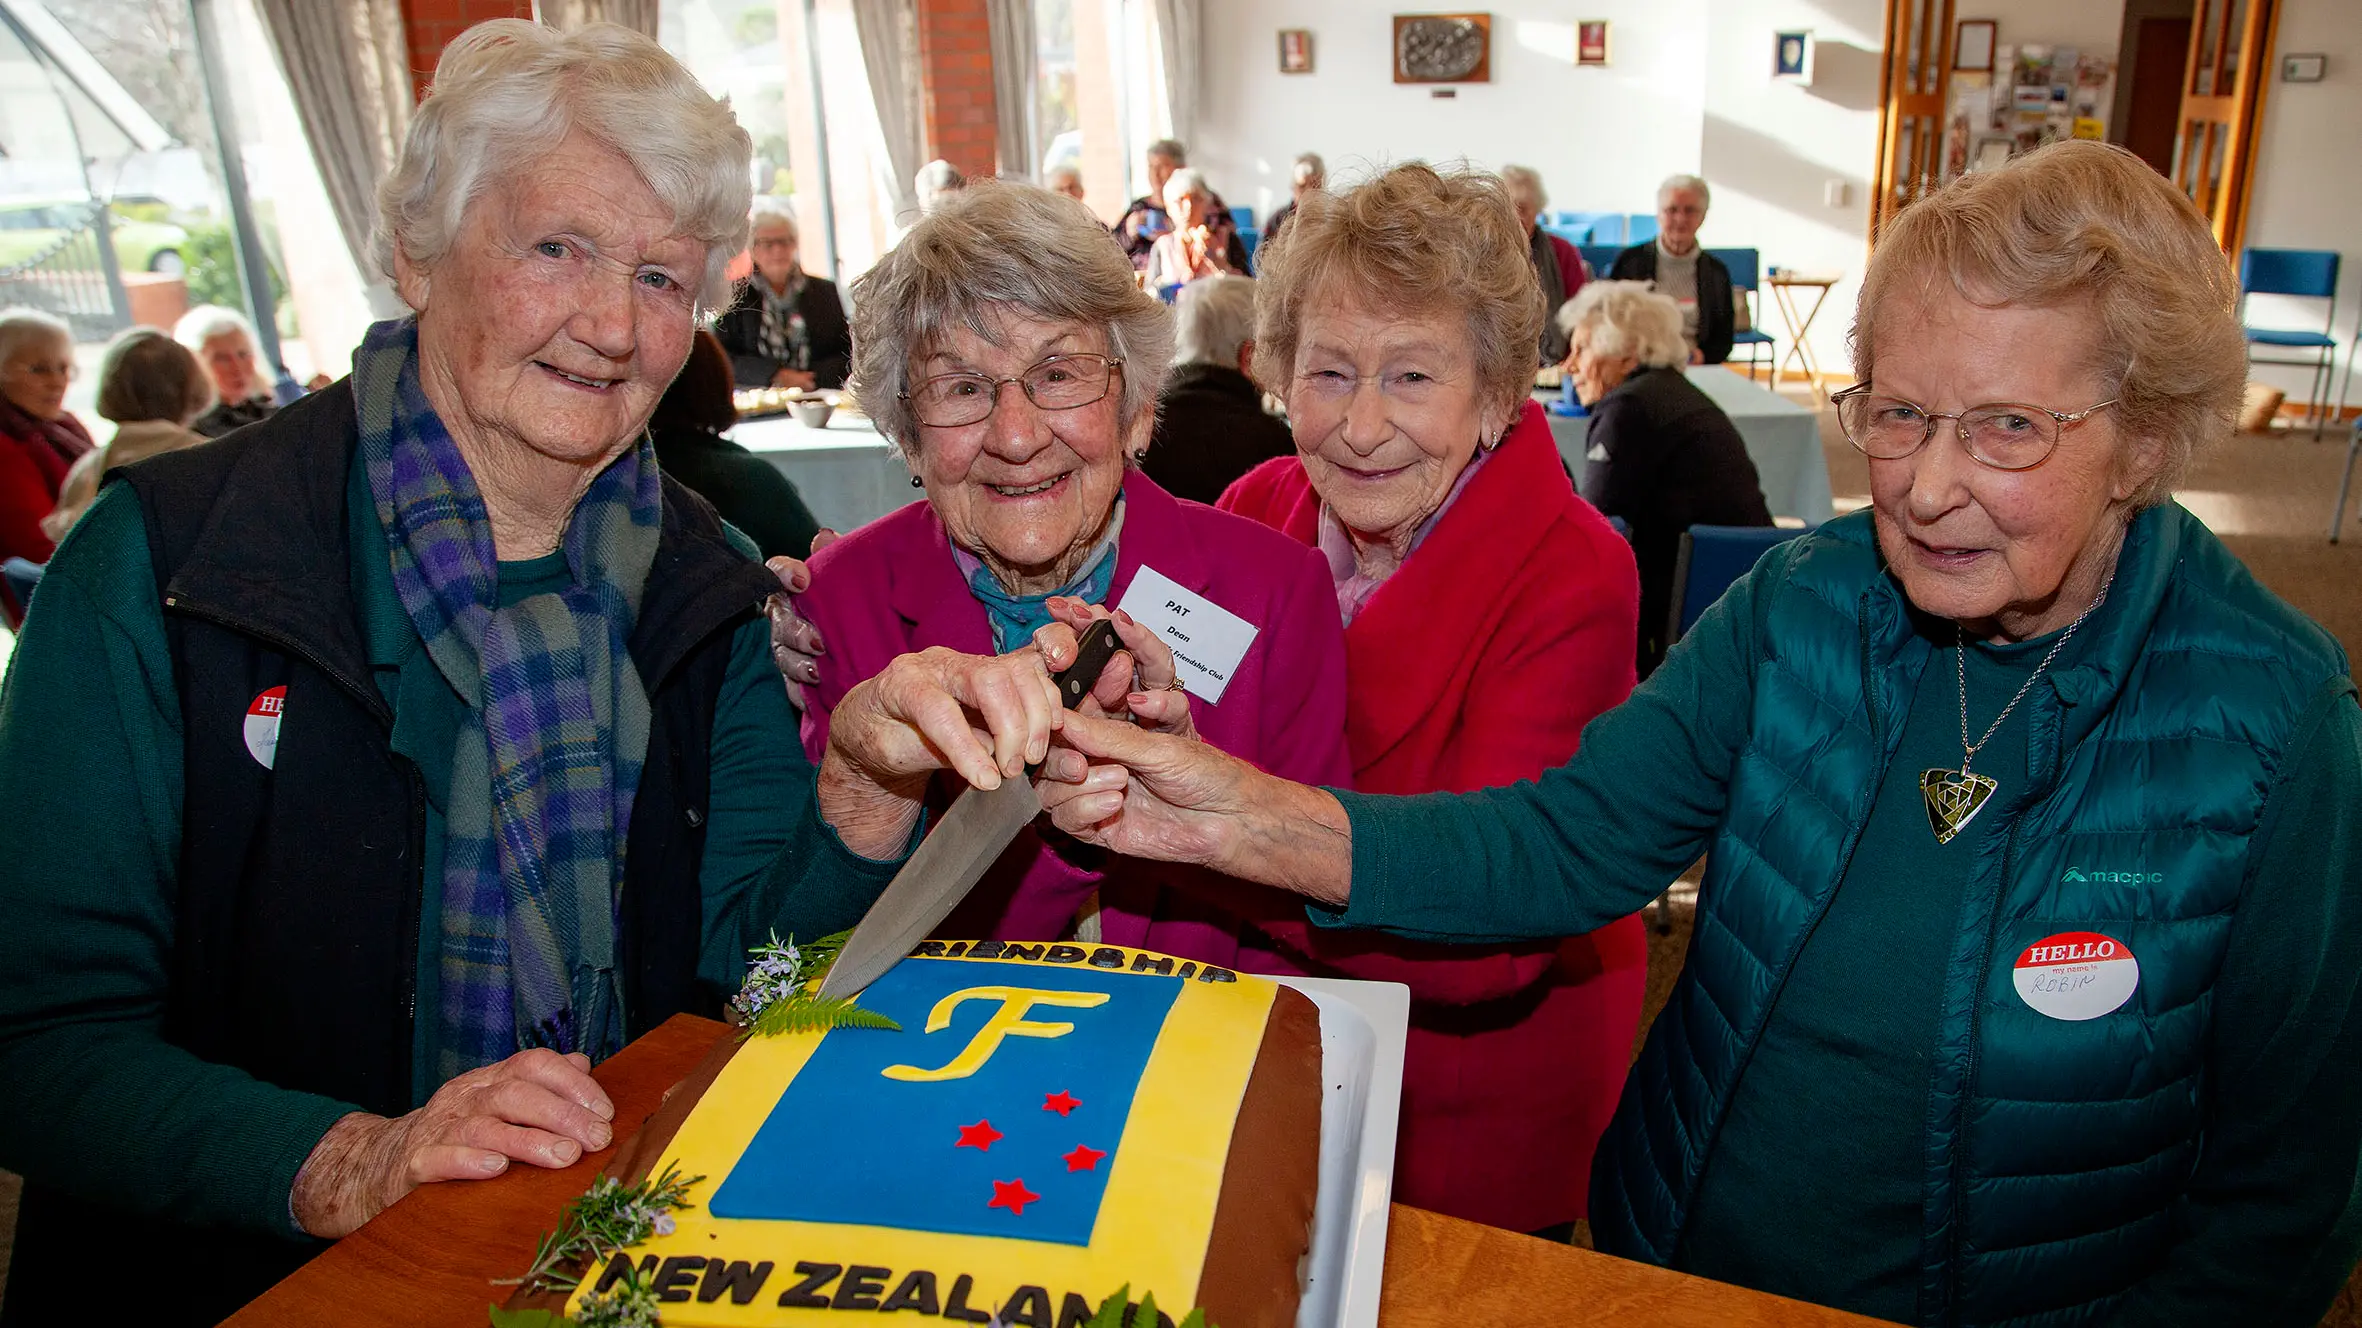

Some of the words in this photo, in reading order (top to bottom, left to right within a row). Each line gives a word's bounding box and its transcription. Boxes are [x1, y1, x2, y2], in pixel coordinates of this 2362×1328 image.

[1165, 600, 1190, 617] PAT
[1167, 626, 1190, 643] Dean
[1173, 650, 1208, 673] Friendship
[1208, 669, 1224, 681] Club
[908, 940, 1237, 984] RIENDSHIP
[2029, 941, 2115, 963] HELLO
[881, 986, 1110, 1082] F
[594, 1252, 775, 1306] NEW
